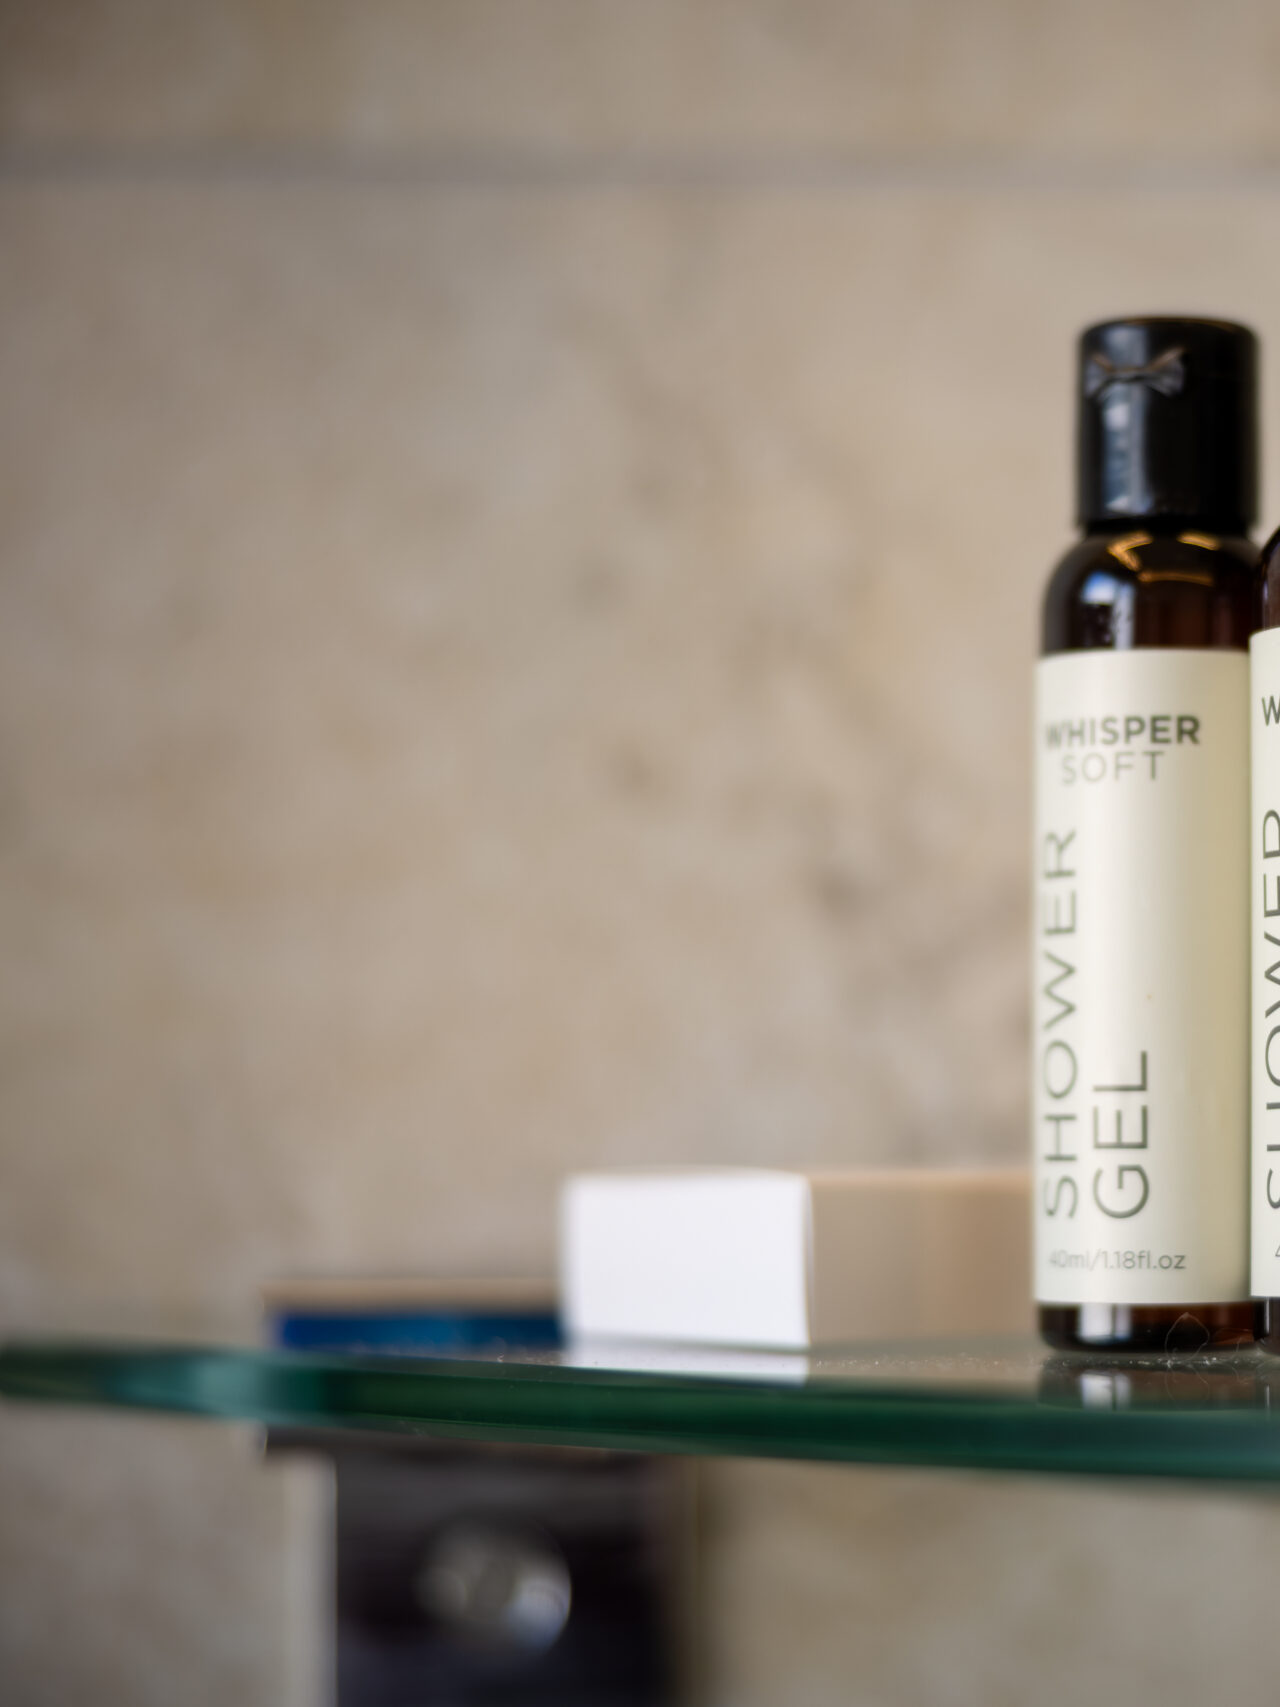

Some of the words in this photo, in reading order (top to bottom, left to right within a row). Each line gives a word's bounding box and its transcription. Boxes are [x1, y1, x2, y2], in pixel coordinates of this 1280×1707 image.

[1046, 714, 1201, 749] WHISPER
[1061, 751, 1165, 785] SOFT
[1043, 828, 1079, 1219] SHOWER
[1092, 1050, 1150, 1219] GEL
[1048, 1249, 1187, 1271] 40ml/1.18fl.oz
